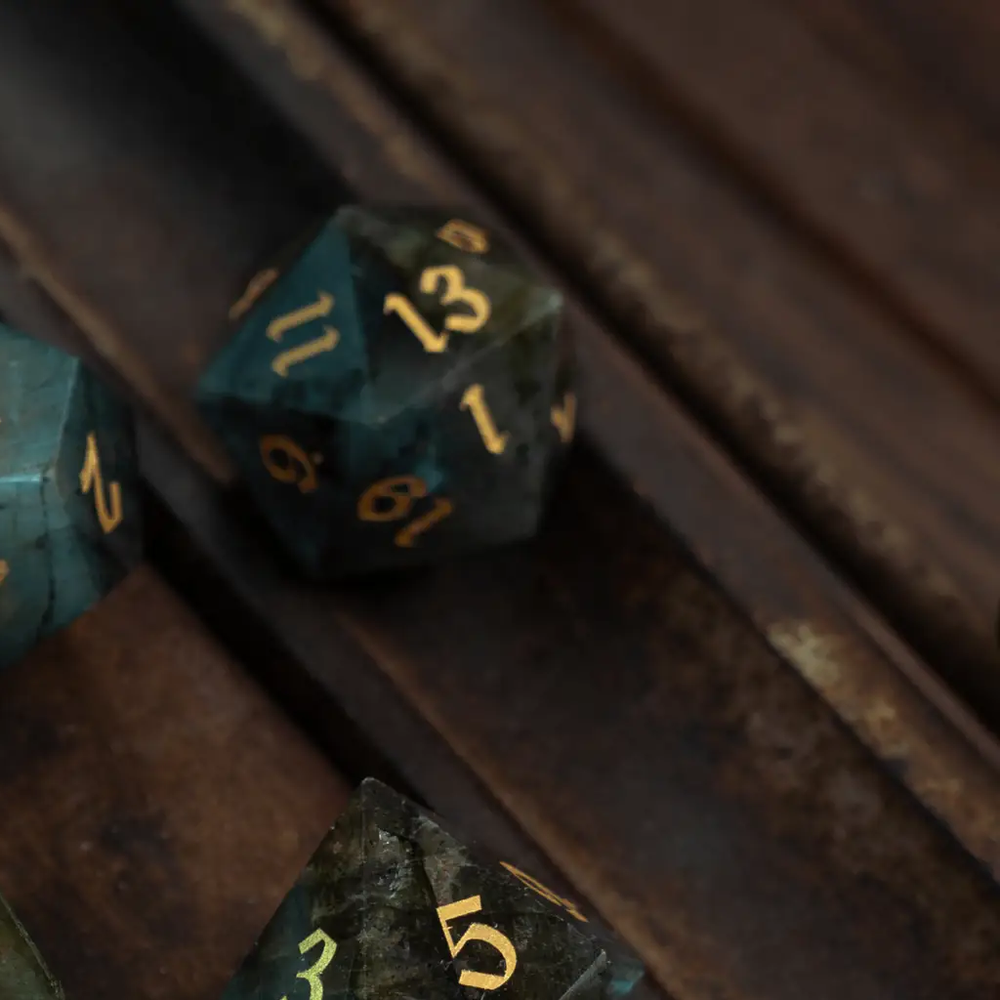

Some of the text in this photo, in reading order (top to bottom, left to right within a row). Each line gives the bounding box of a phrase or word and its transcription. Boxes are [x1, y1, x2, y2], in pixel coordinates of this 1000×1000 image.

[265, 289, 341, 379] 11
[383, 264, 492, 353] 13
[459, 383, 510, 455] 1
[79, 429, 123, 535] 2
[435, 894, 518, 991] 5
